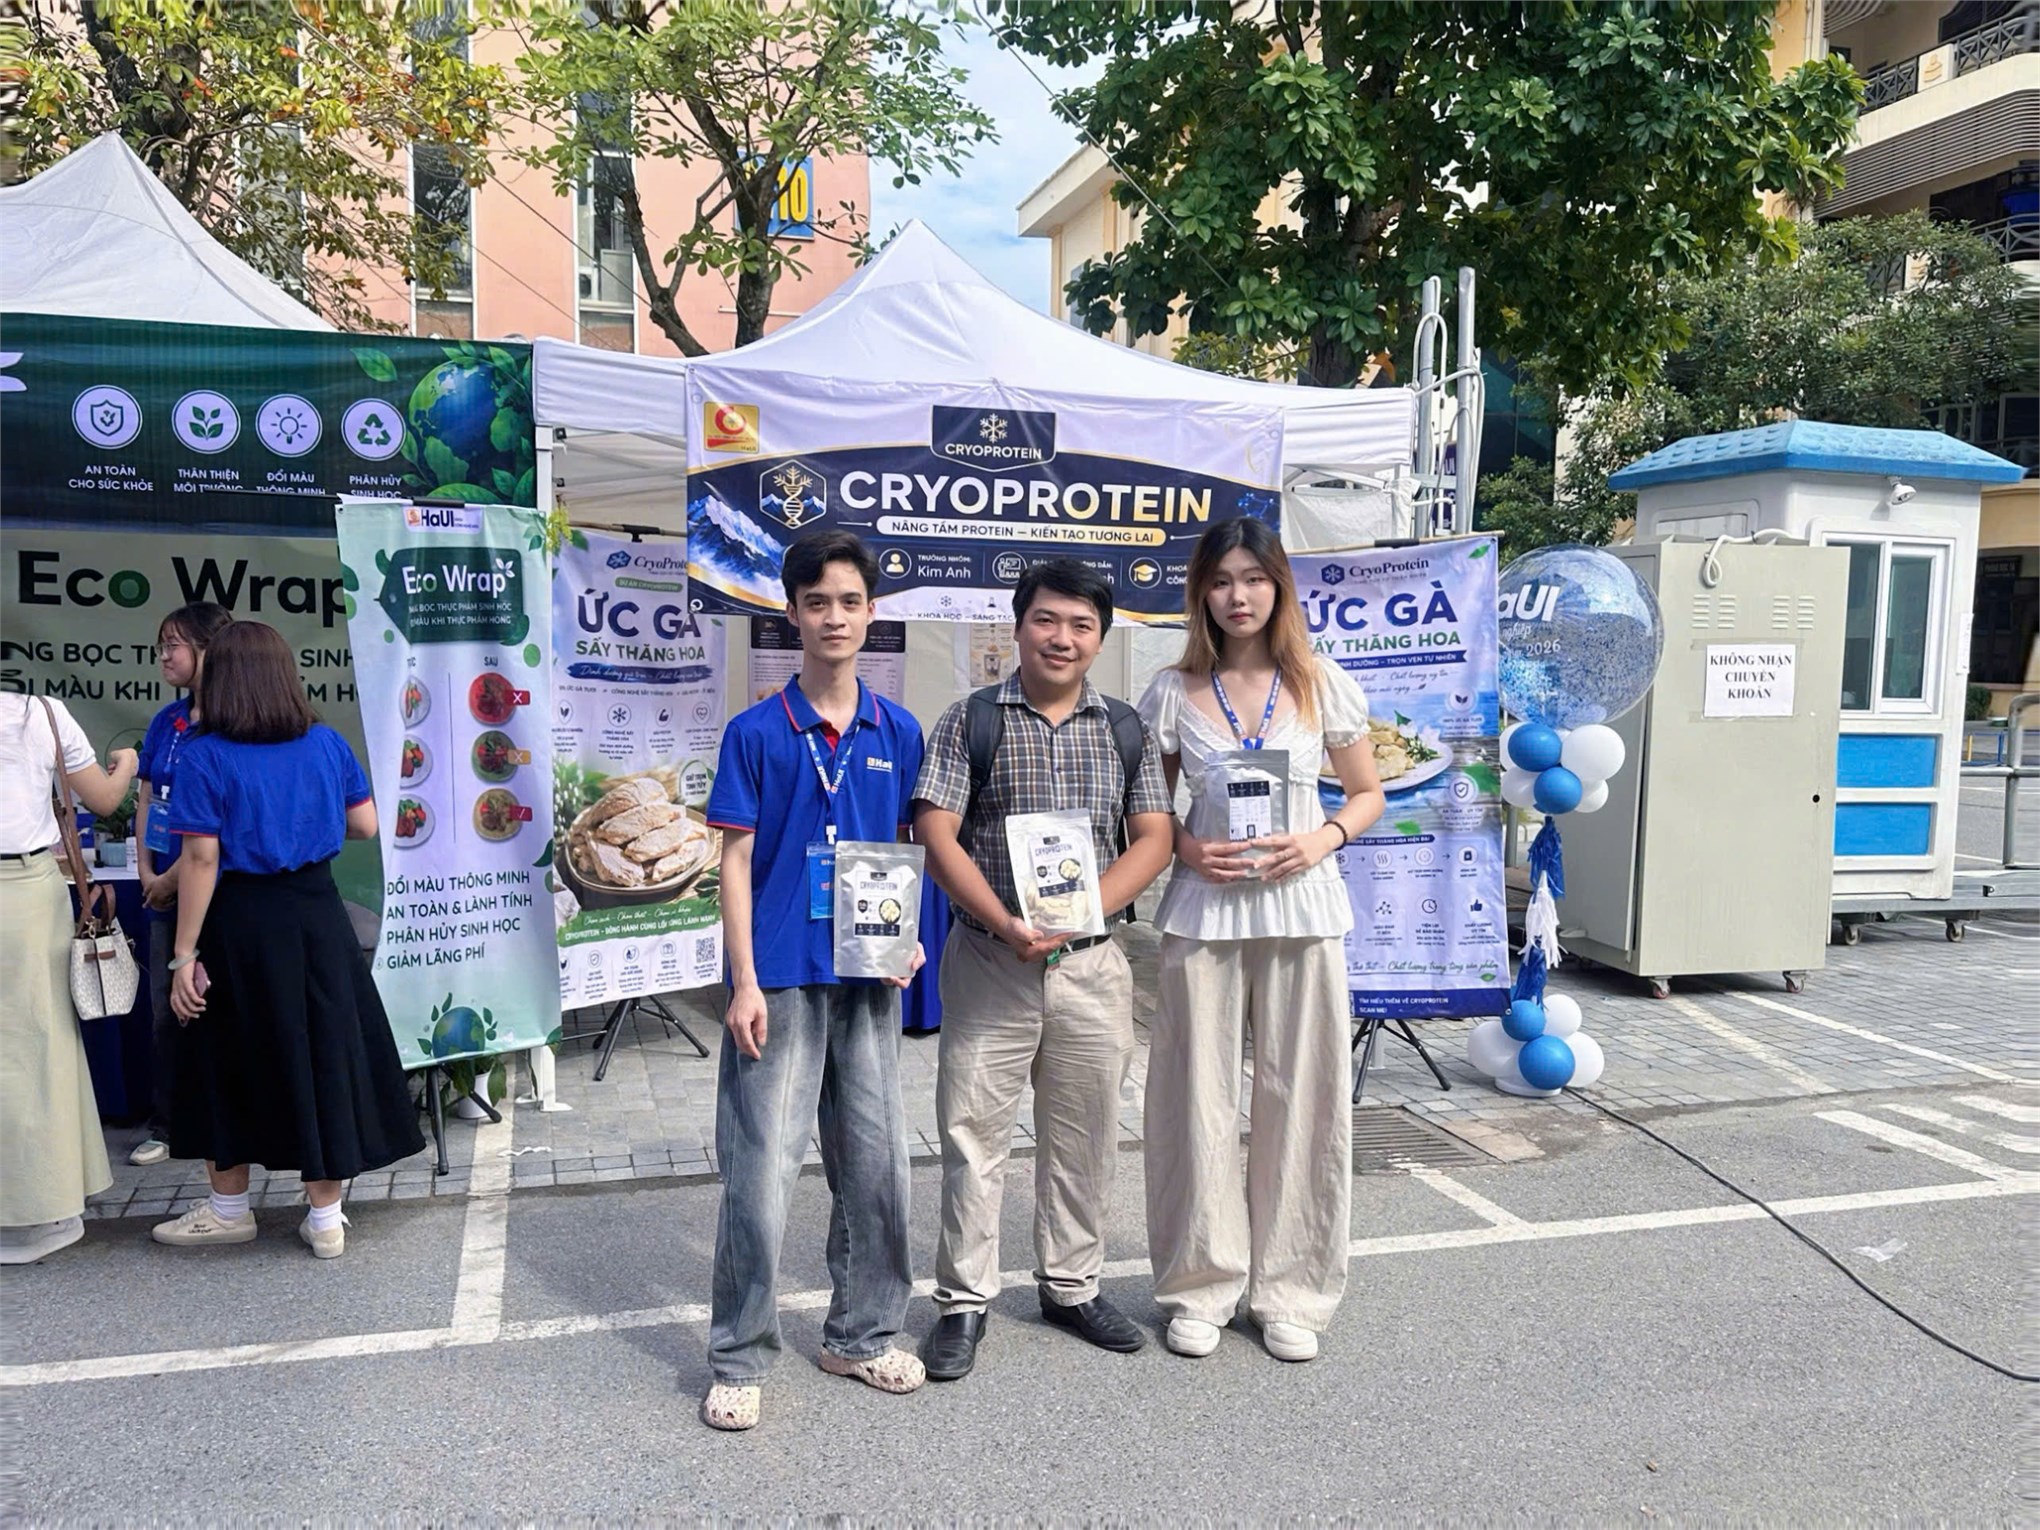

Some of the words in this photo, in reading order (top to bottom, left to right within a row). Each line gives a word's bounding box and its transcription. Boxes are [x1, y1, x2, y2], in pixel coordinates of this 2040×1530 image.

[945, 443, 1042, 460] CRYOPROTEIN
[85, 466, 101, 475] AN
[104, 464, 136, 476] TOÀN
[290, 471, 315, 483] MÀU
[69, 479, 94, 489] CHO
[98, 478, 120, 490] SỨC
[174, 482, 196, 492] MÔI
[840, 471, 1212, 523] CRYOPROTEIN
[421, 509, 454, 527] HaUI
[892, 520, 929, 533] NÂNG
[962, 525, 1014, 537] PROTEIN
[1031, 525, 1059, 539] KIẾN
[1062, 529, 1085, 542] TẠO
[1088, 530, 1132, 542] TƯƠNG
[1136, 532, 1154, 542] LAI
[634, 555, 688, 572] CryoProte
[918, 565, 942, 578] Kim
[945, 567, 971, 579] Anh
[1349, 558, 1429, 579] CryoProtein
[18, 550, 150, 608] Eco
[171, 556, 347, 628] Wrap
[442, 565, 506, 599] Wrap
[578, 588, 640, 638] ỨC
[1302, 590, 1368, 633] ỨC
[1385, 580, 1458, 627] GÀ
[1499, 584, 1561, 622] aUI
[576, 637, 611, 657] SẤY
[615, 643, 676, 663] THĂNG
[679, 645, 706, 661] HOA
[1312, 634, 1336, 655] ẤY
[1342, 631, 1412, 654] THĂNG
[1418, 631, 1461, 647] HOA
[1526, 638, 1561, 657] 2026
[64, 643, 122, 667] BỌC
[484, 656, 498, 666] SAU
[1710, 651, 1755, 666] KHÔNG
[45, 674, 104, 700] MÀU
[115, 681, 160, 701] KHI
[414, 876, 445, 894] MÀU
[449, 871, 493, 891] THÔNG
[496, 871, 530, 885] MINH
[386, 905, 405, 921] AN
[409, 901, 448, 919] TOÀN
[452, 905, 462, 914] &
[465, 896, 497, 913] LÀNH
[501, 891, 533, 907] TÍNH
[386, 926, 425, 945] PHÂN
[429, 922, 458, 941] HỦY
[460, 921, 489, 937] SINH
[492, 917, 521, 935] HỌC
[387, 950, 421, 970] GIẢM
[465, 942, 485, 961] PHÍ
